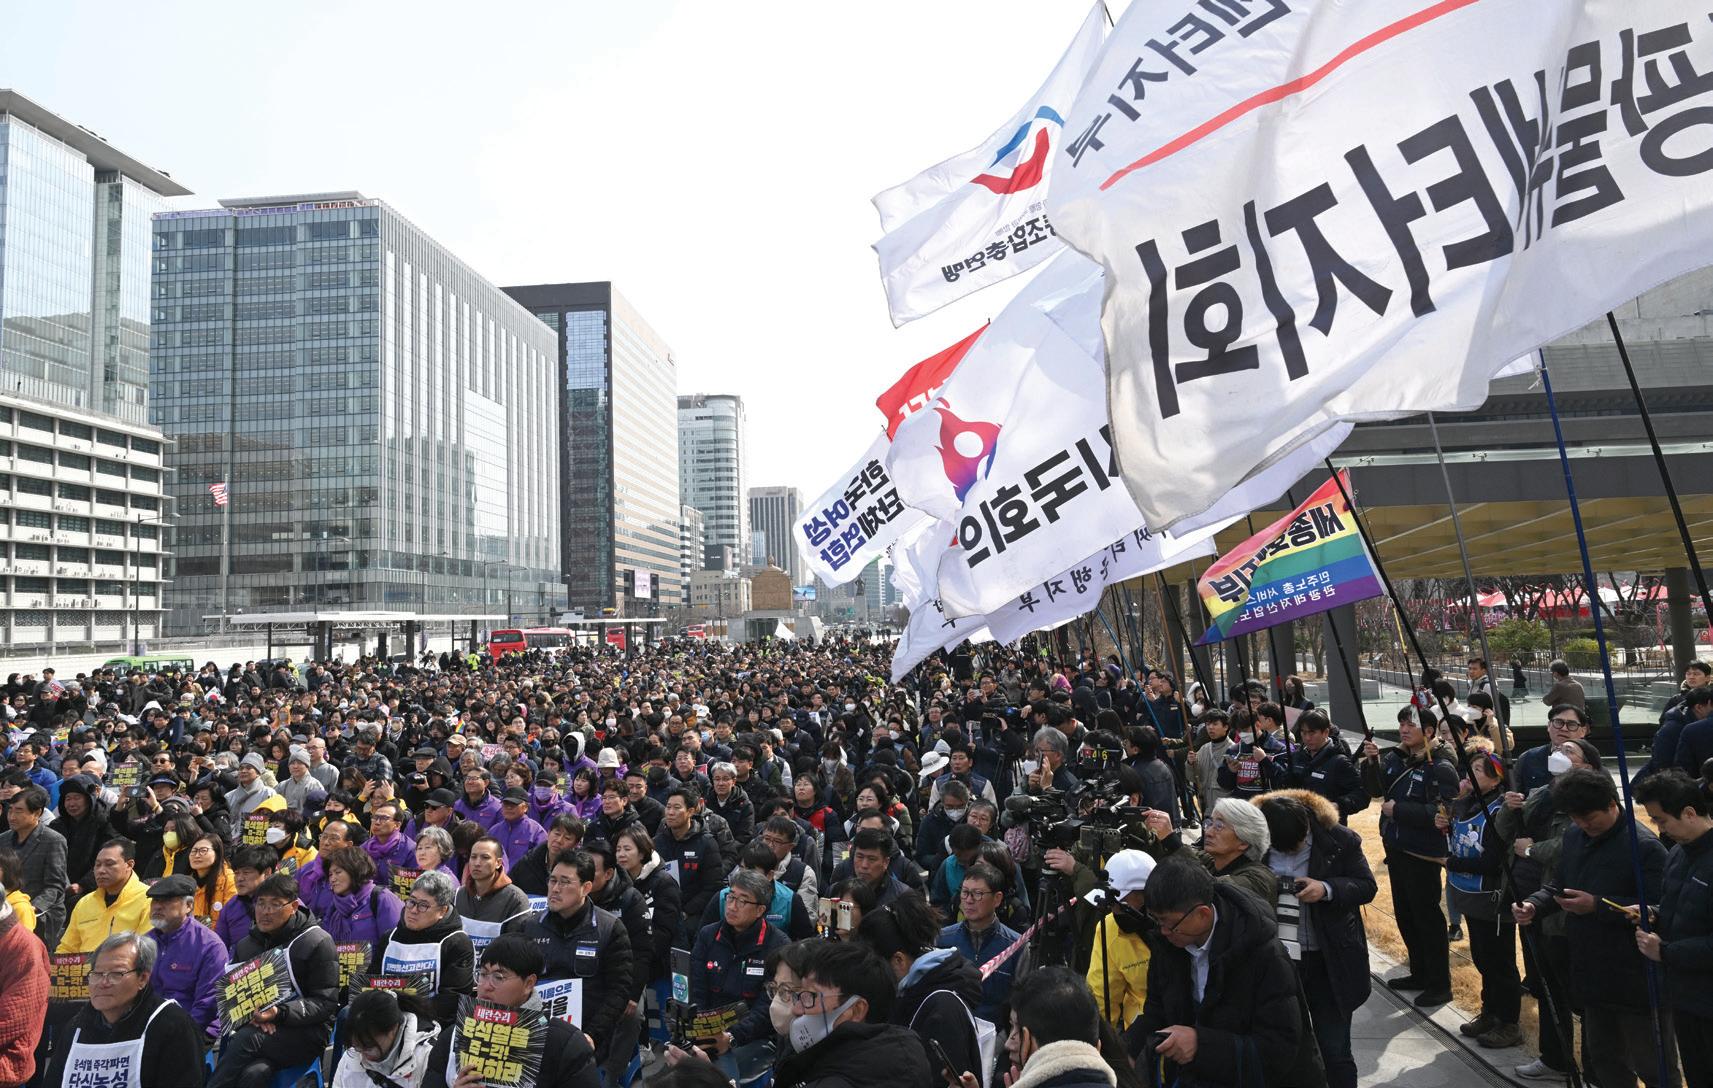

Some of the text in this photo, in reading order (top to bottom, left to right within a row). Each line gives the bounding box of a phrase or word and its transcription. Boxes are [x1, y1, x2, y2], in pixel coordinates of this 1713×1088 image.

[477, 1008, 511, 1023] 내란수괴
[463, 1016, 530, 1048] 윤석열을
[74, 1058, 93, 1071] 윤석열
